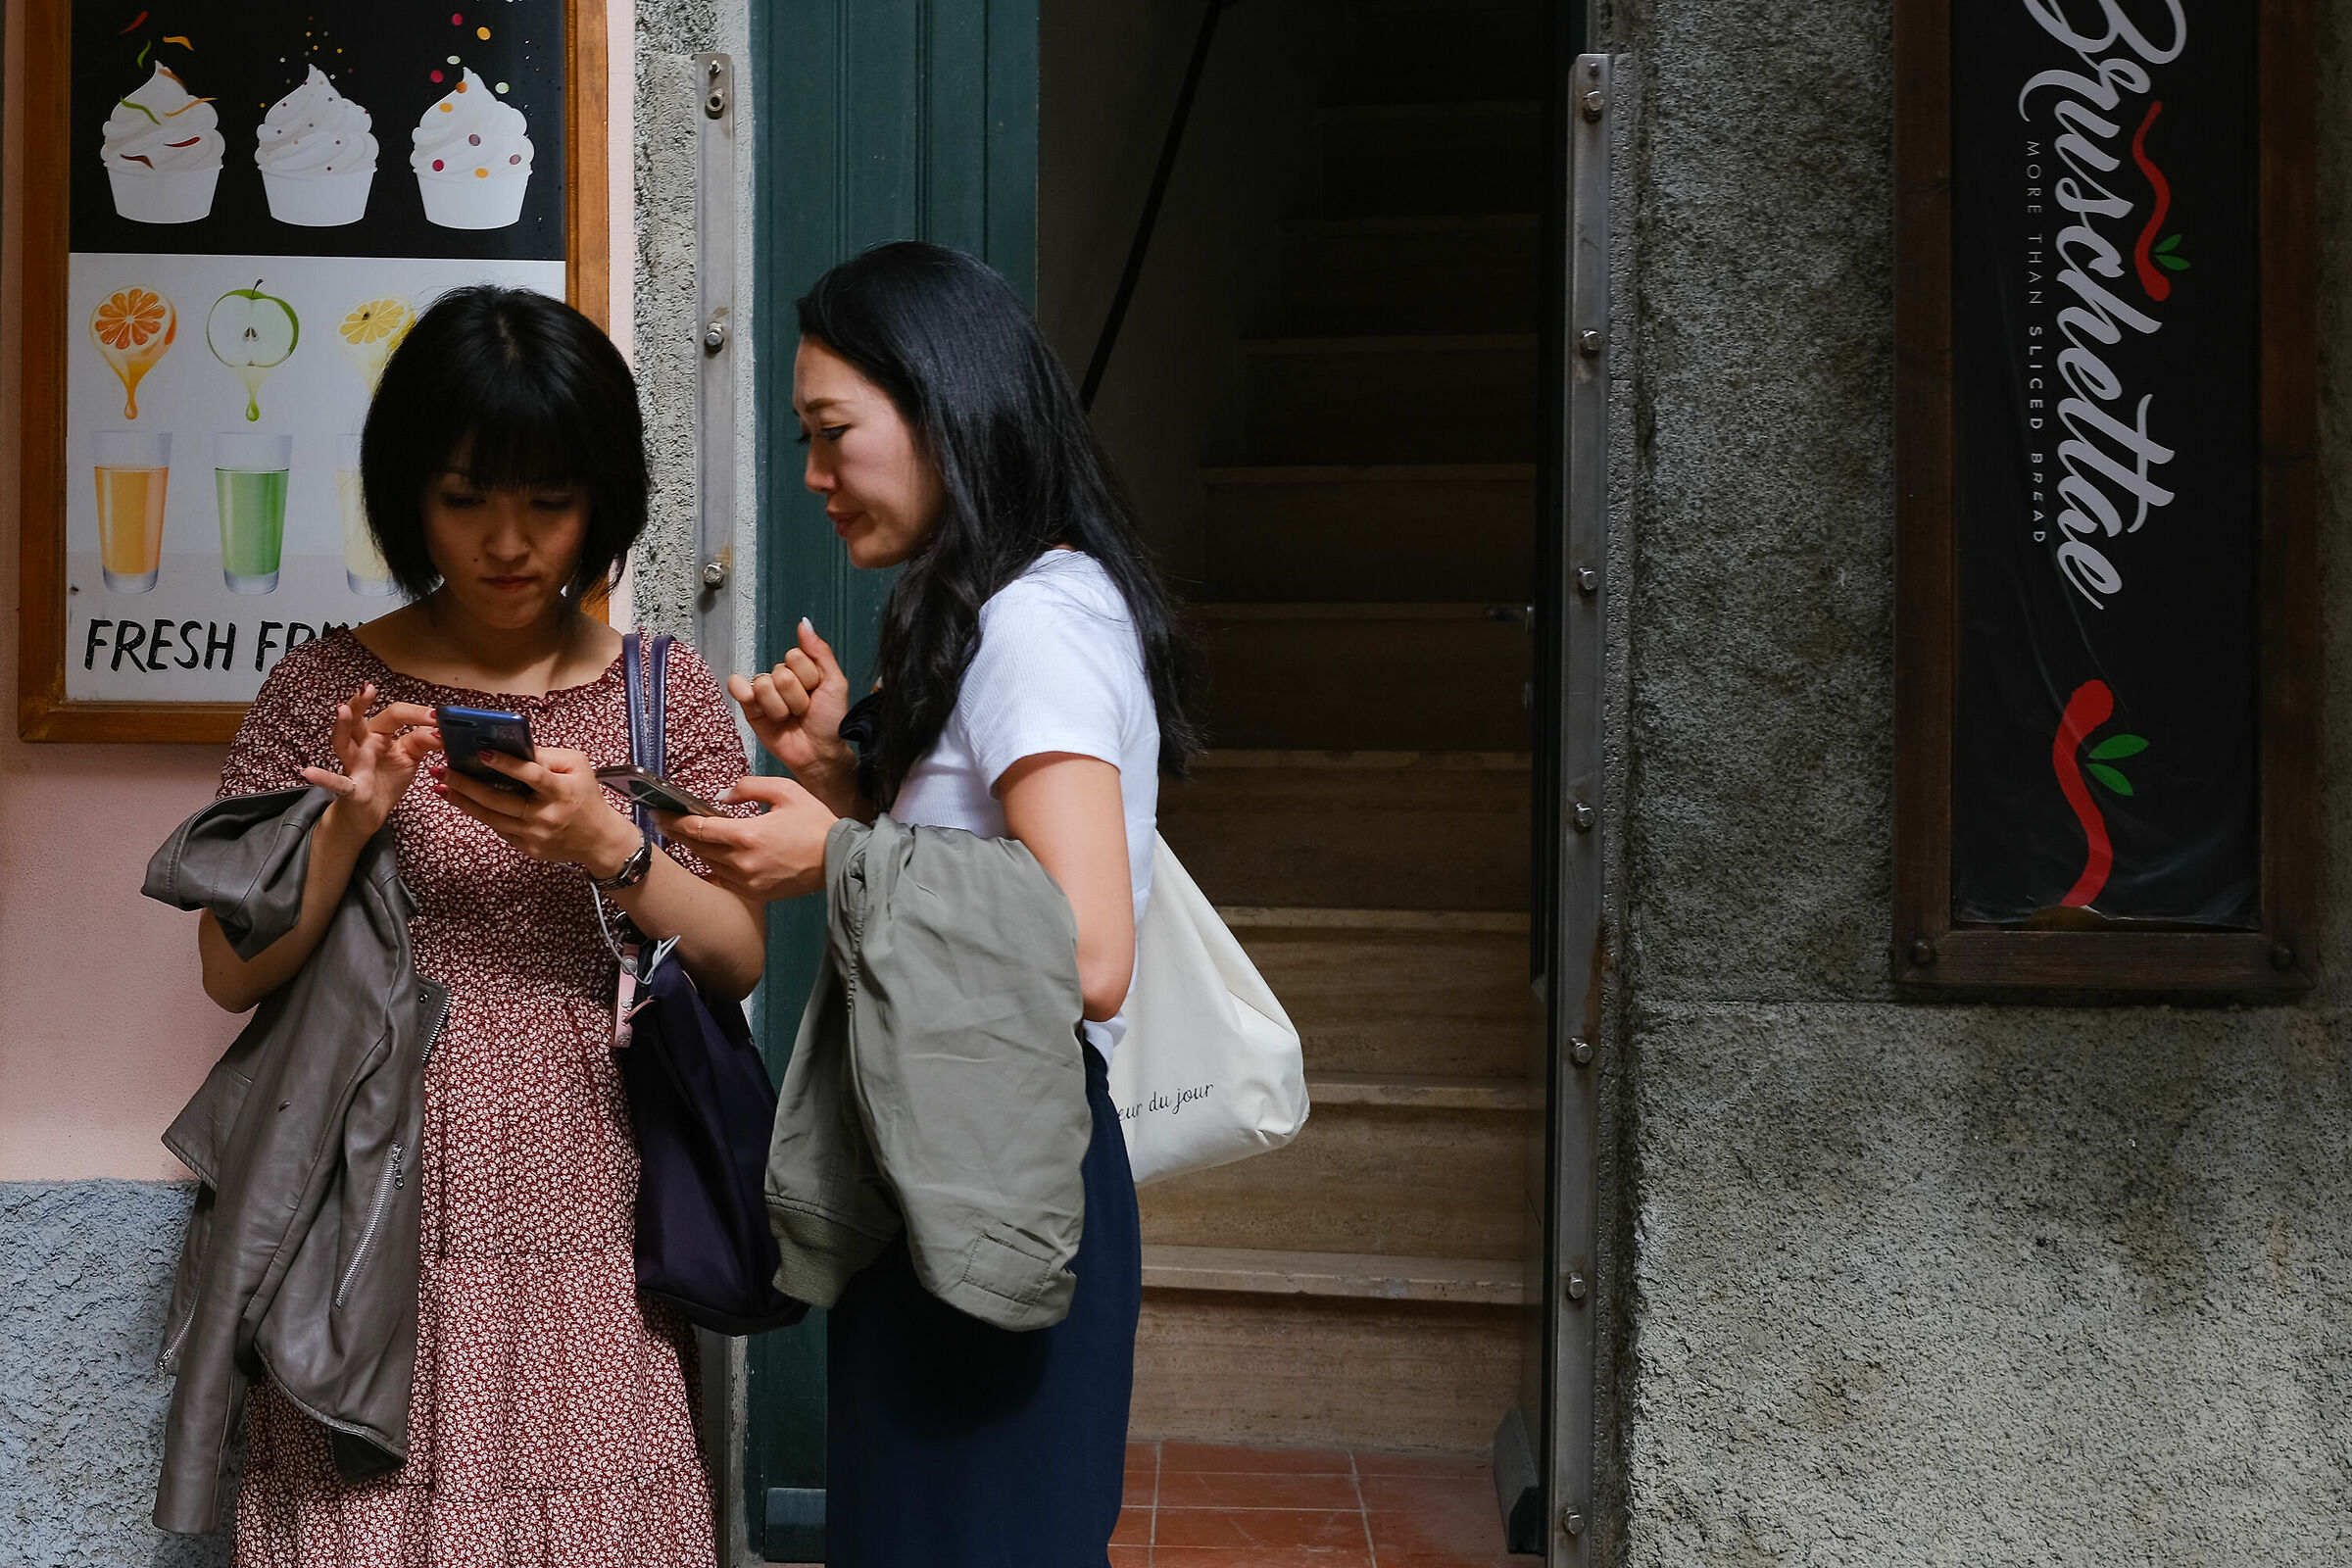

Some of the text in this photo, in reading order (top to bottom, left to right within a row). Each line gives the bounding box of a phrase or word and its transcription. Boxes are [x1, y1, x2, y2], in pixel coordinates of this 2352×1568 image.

[2027, 140, 2046, 543] MORE THAN SLICED BREAD
[84, 618, 237, 672] FRESH
[1117, 1083, 1214, 1121] eur du jour
